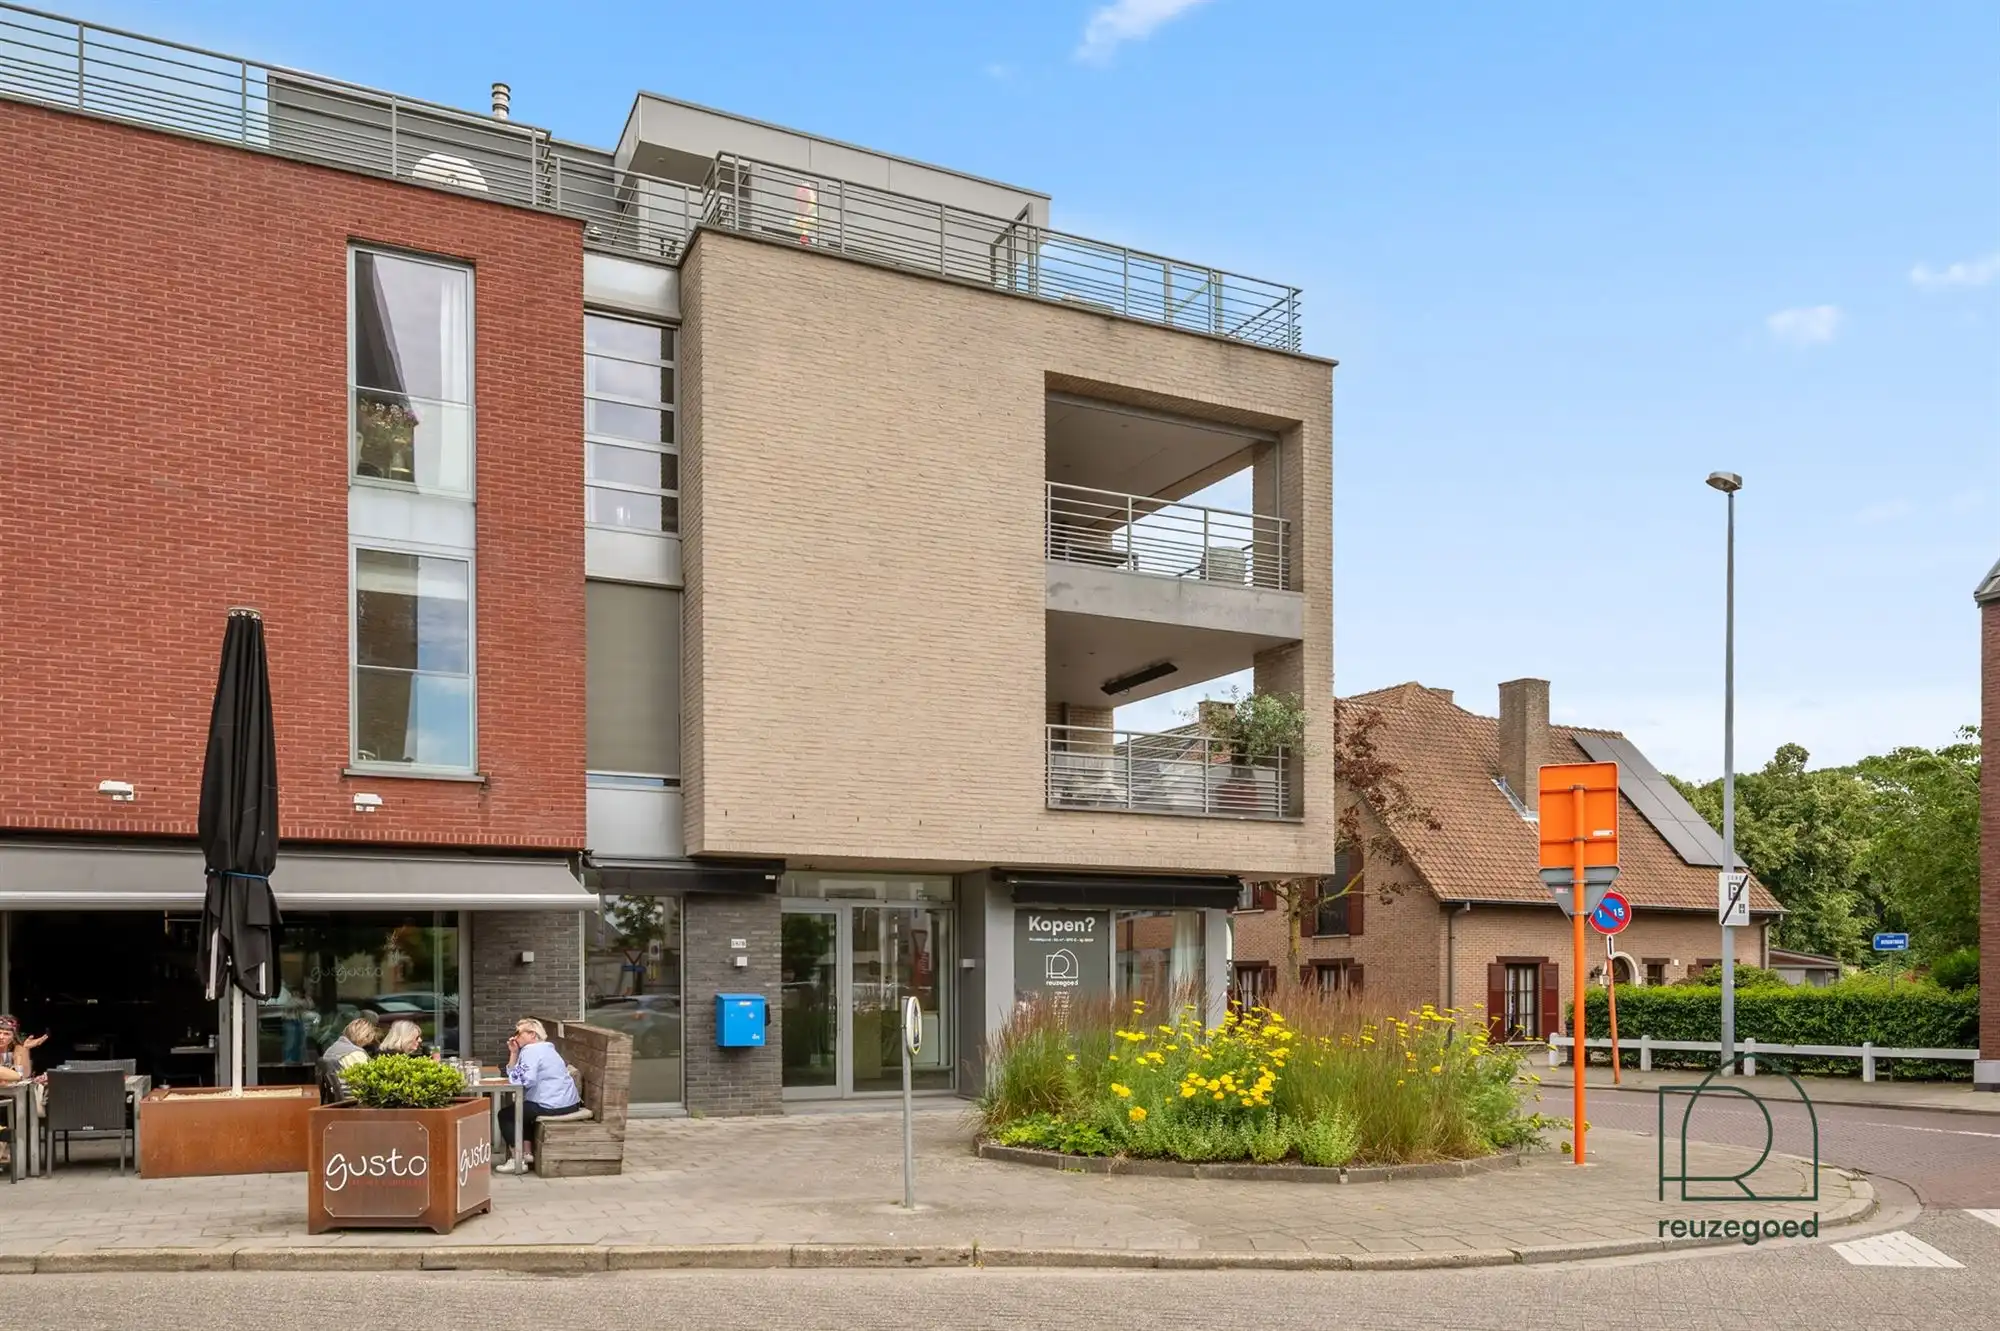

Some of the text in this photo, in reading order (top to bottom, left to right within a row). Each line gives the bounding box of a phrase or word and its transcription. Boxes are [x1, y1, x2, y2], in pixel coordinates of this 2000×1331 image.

[1613, 907, 1624, 917] 15
[1028, 916, 1095, 936] Kopen?
[1046, 979, 1079, 987] reuzegoed
[325, 1148, 427, 1191] gusto
[459, 1138, 491, 1187] gusto
